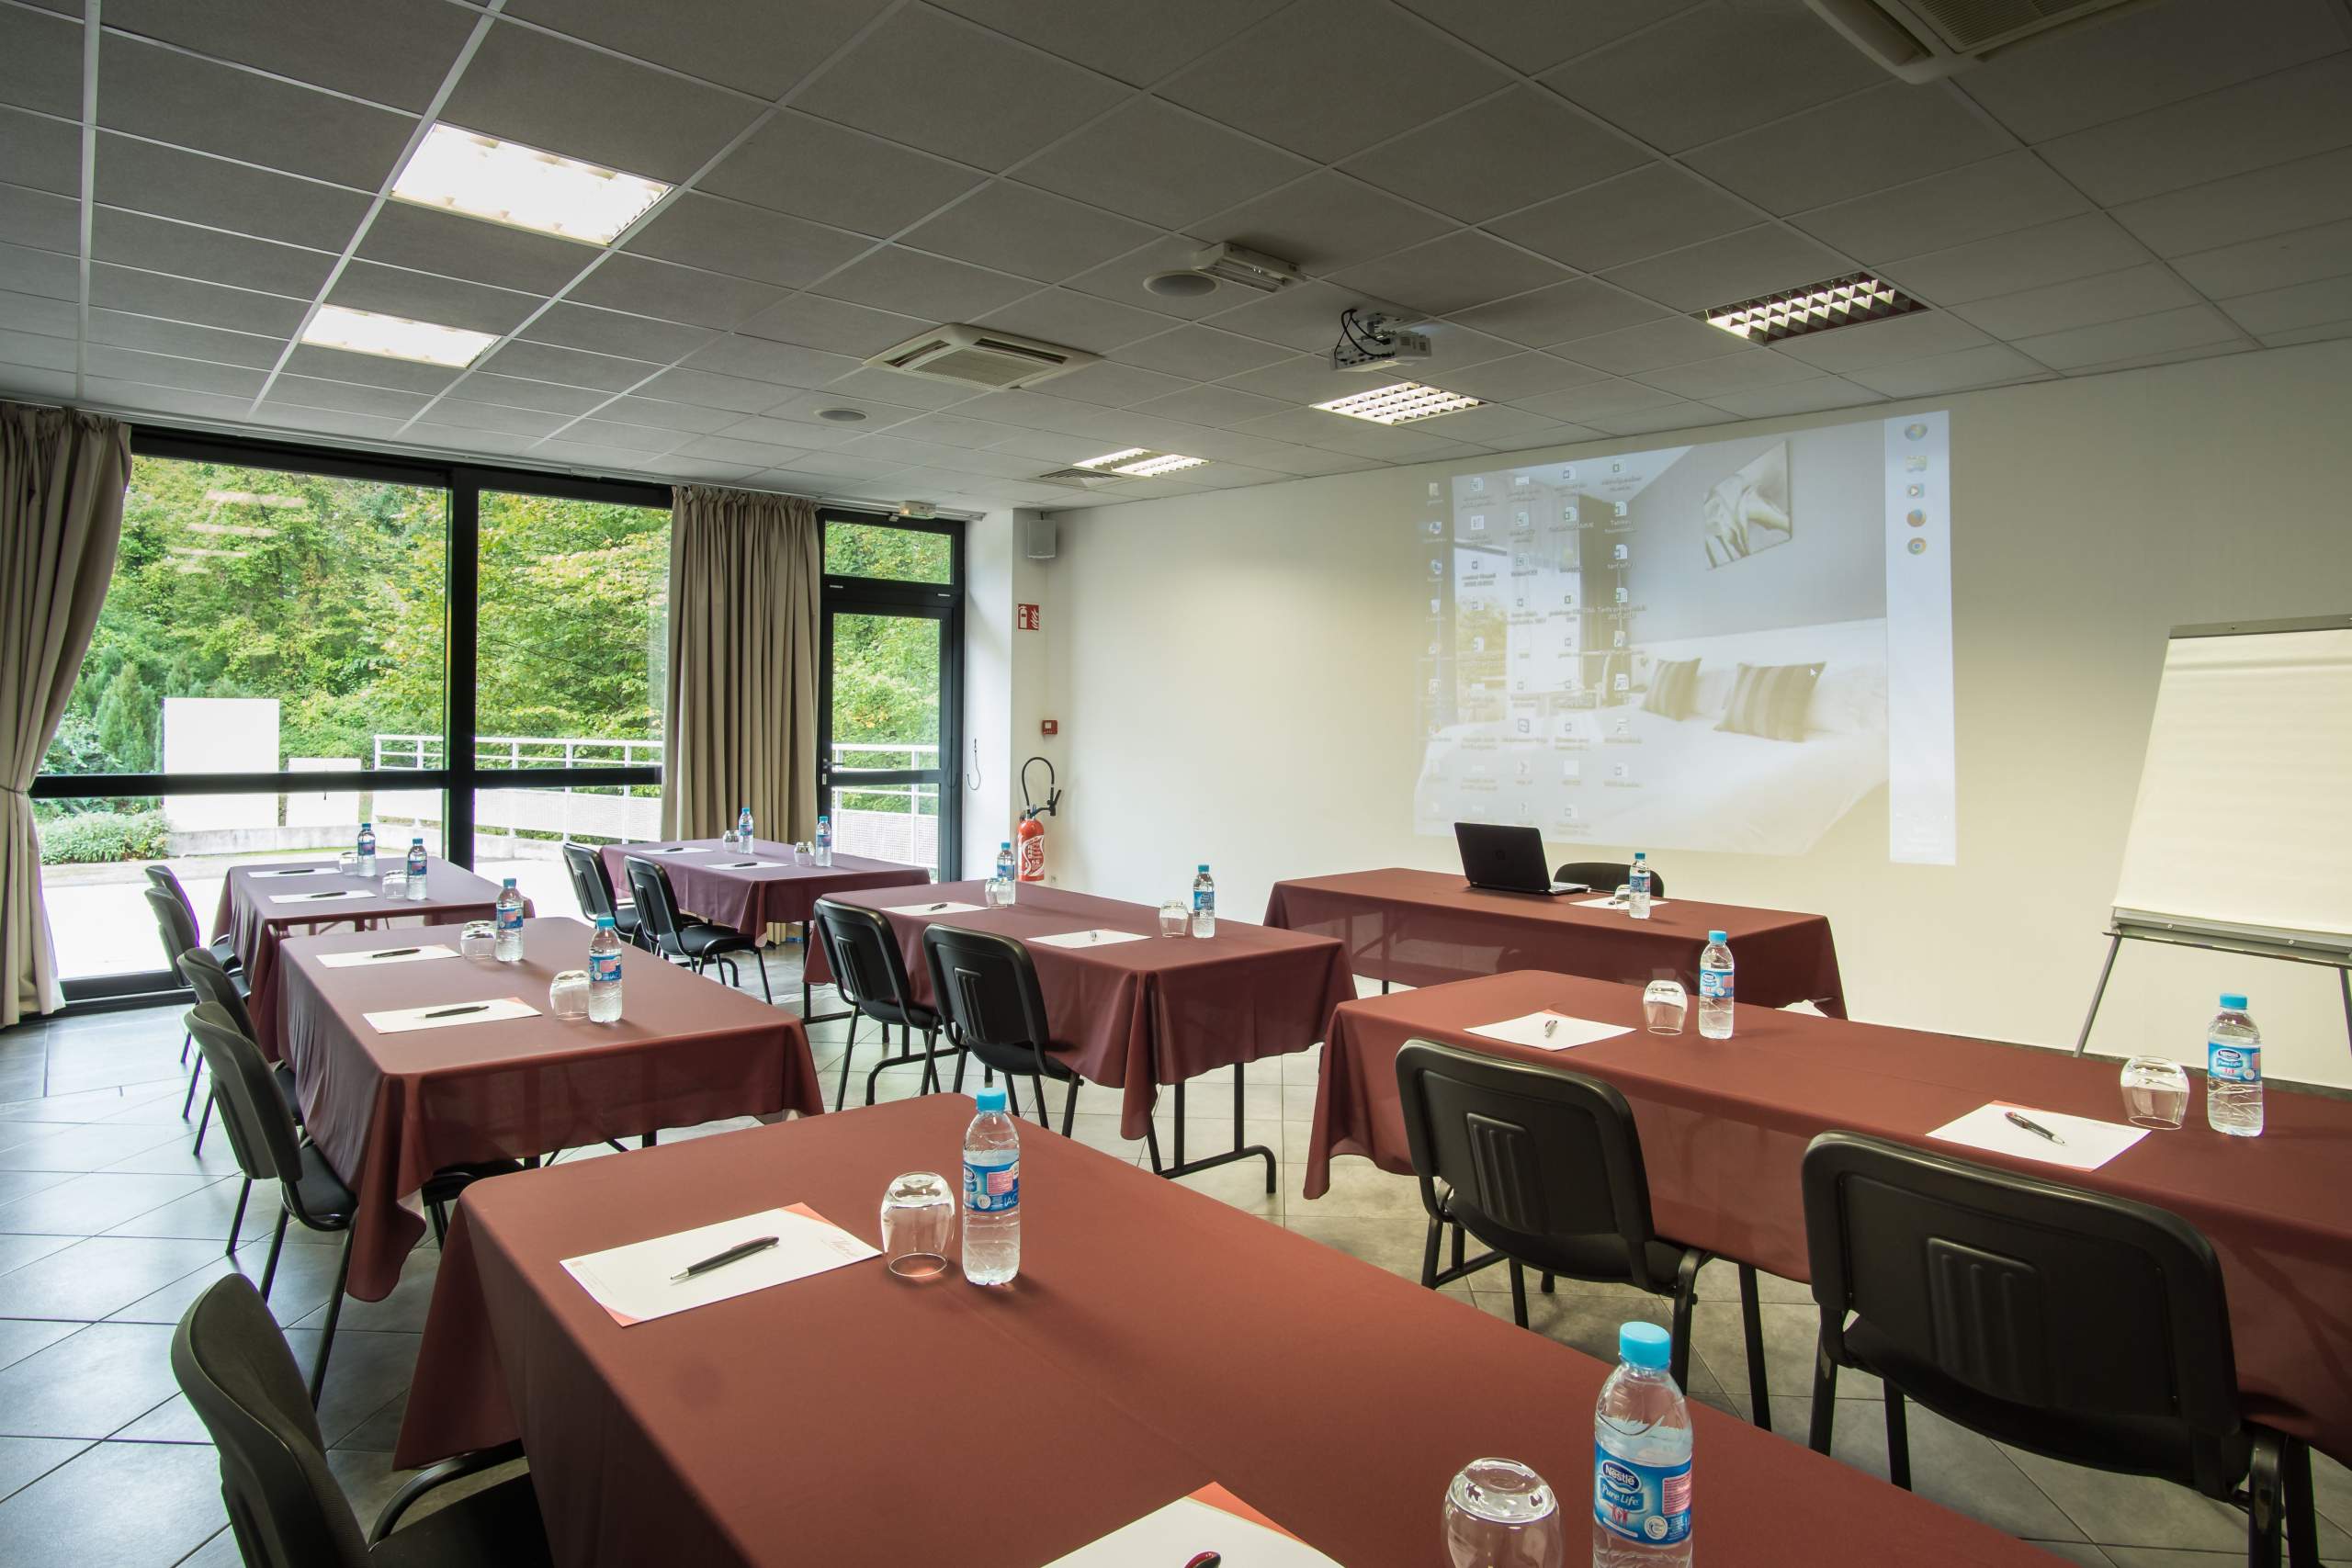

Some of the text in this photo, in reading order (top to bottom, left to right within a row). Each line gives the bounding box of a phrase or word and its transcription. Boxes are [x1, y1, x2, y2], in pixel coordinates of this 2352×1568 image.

[1605, 1464, 1635, 1485] Nestlé
[1602, 1485, 1640, 1506] Pure Life
